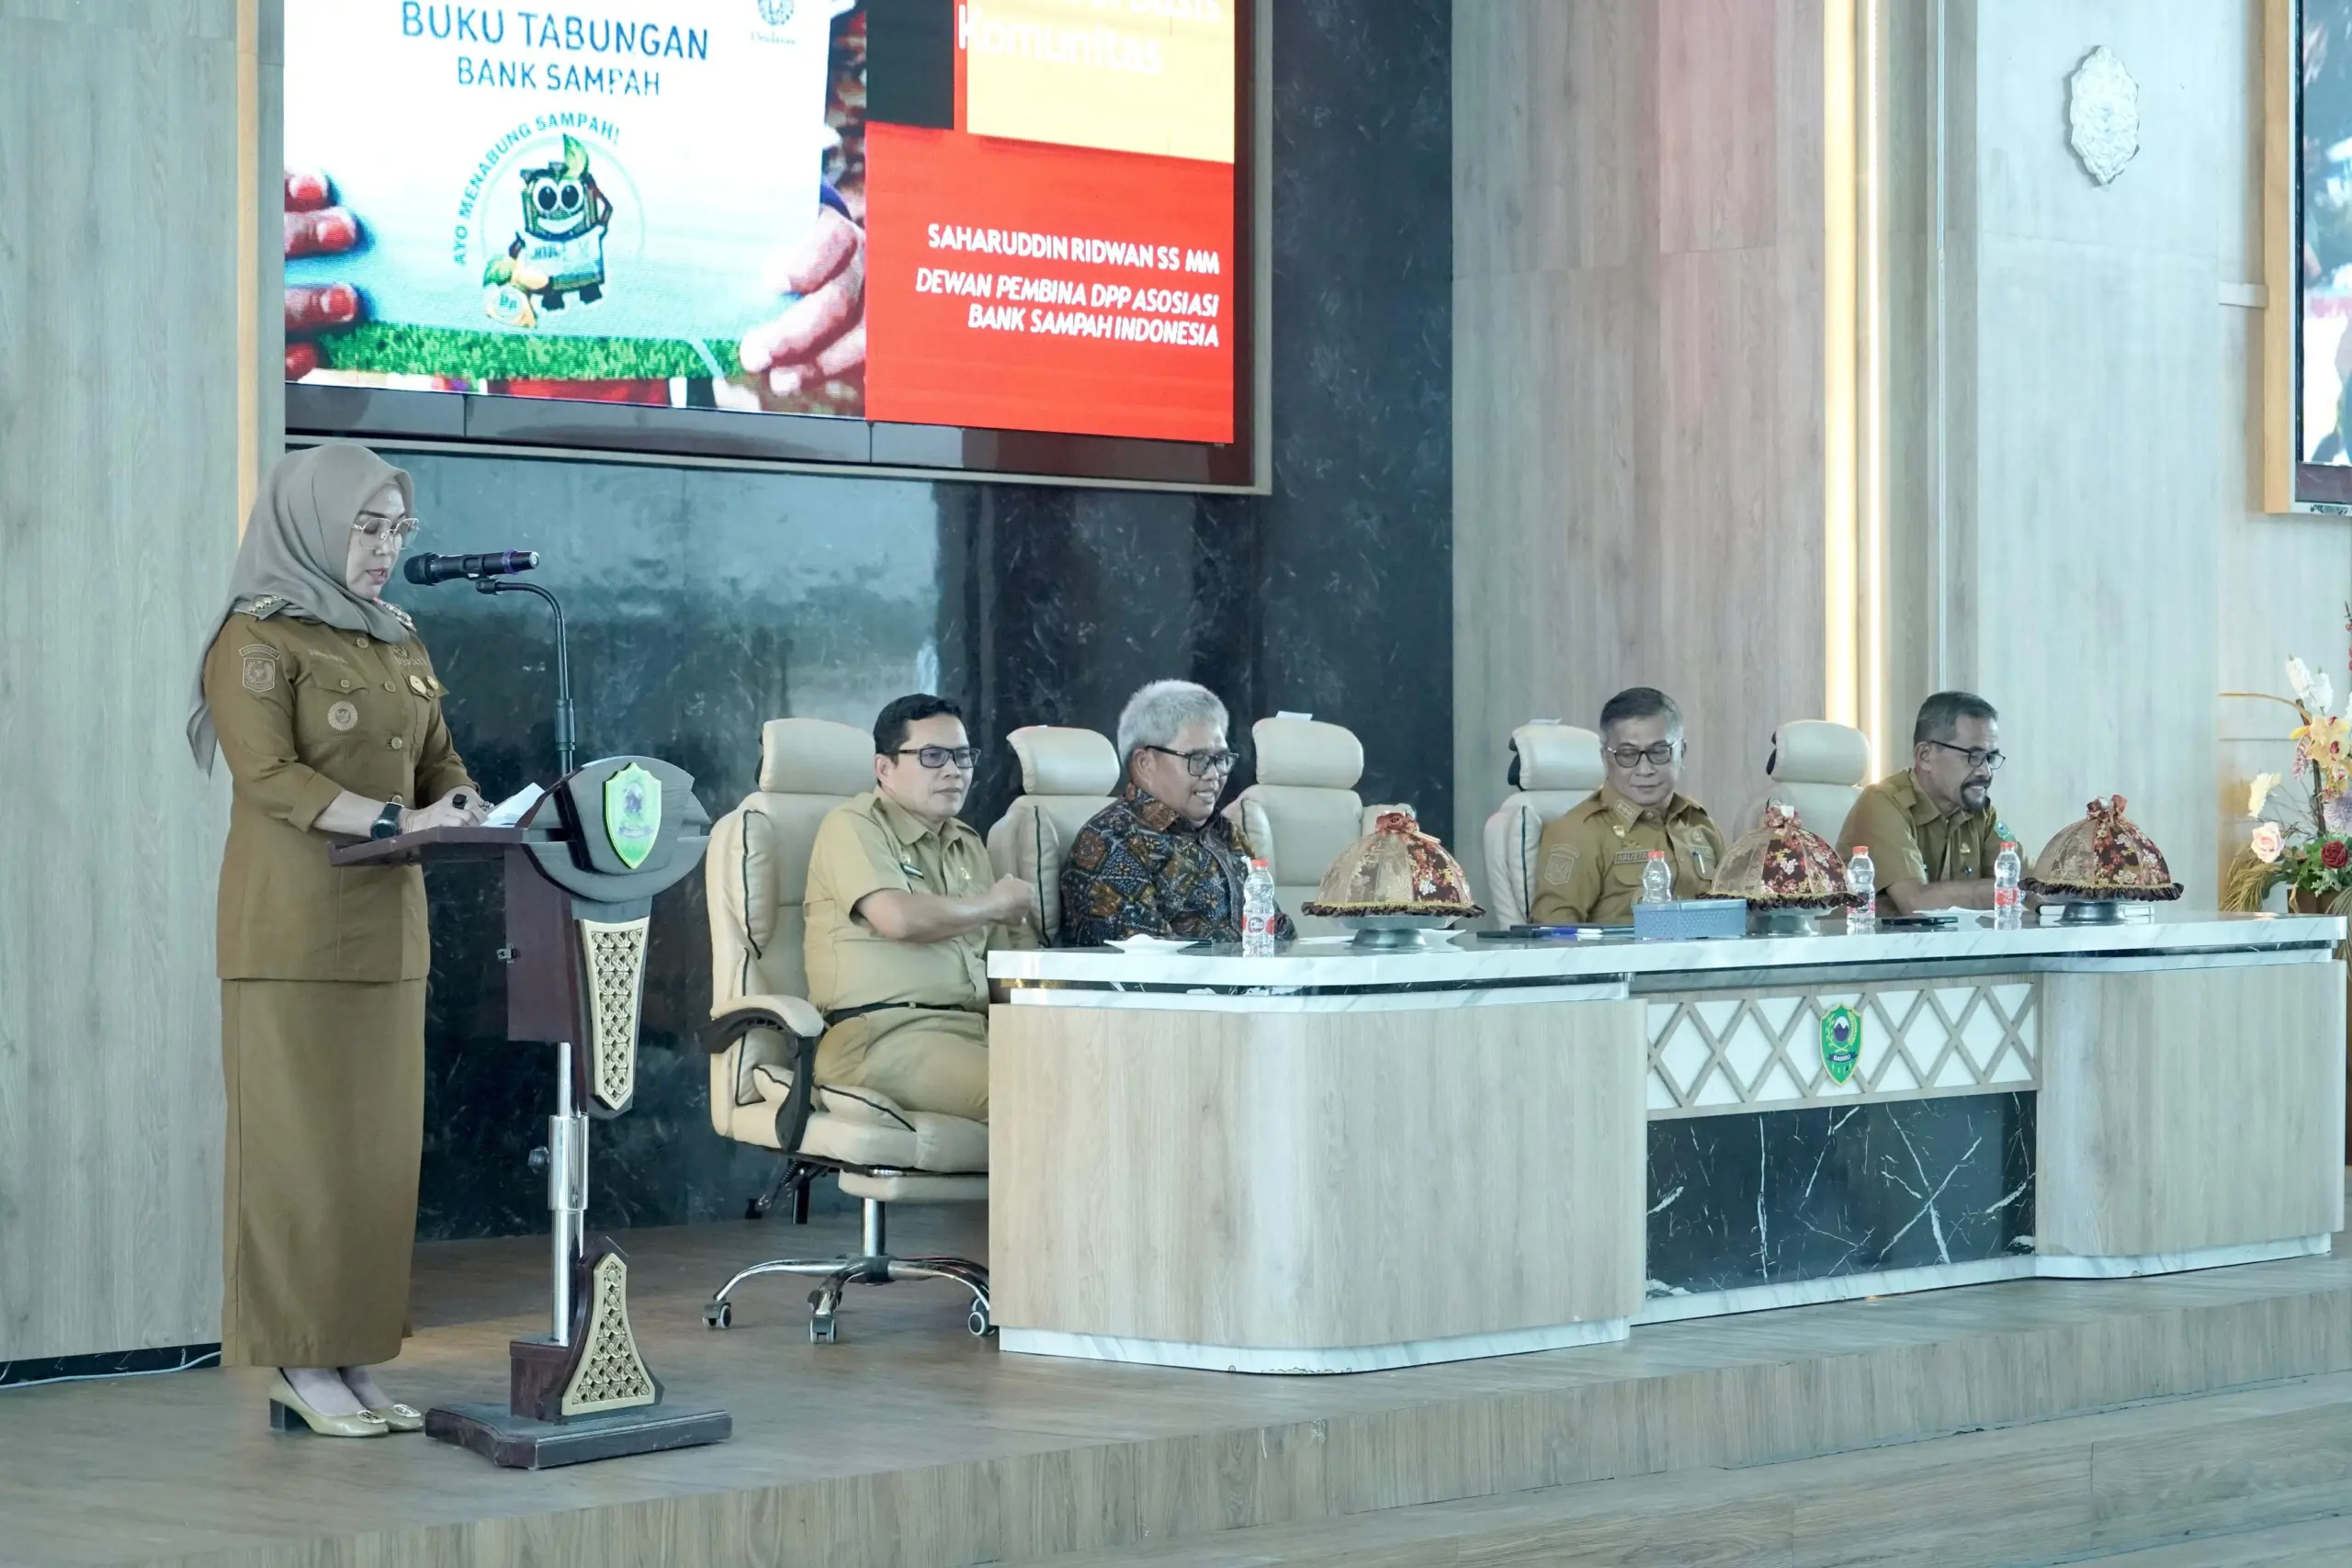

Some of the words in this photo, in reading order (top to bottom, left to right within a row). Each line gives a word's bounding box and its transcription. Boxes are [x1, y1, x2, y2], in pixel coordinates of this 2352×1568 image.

[401, 0, 504, 42] BUKU
[518, 12, 709, 61] TABUNGAN
[958, 4, 1163, 74] Komunitas
[458, 56, 537, 90] BANK
[547, 63, 661, 96] SAMPAH
[535, 111, 621, 146] SAMPAH!
[458, 121, 533, 220] MENABUNG
[453, 224, 469, 265] AYO
[928, 222, 1069, 261] SAHARUDDIN
[1071, 236, 1154, 268] RIDWAN
[1157, 245, 1180, 271] SS
[1185, 249, 1220, 275] MM
[915, 267, 993, 298] DEWAN
[996, 274, 1086, 306] PEMBINA
[1091, 279, 1130, 310] DPP
[1132, 288, 1219, 317] ASOSIASI
[968, 303, 1025, 332] BANK
[1030, 309, 1114, 339] SAMPAH
[1114, 318, 1219, 347] INDONESIA
